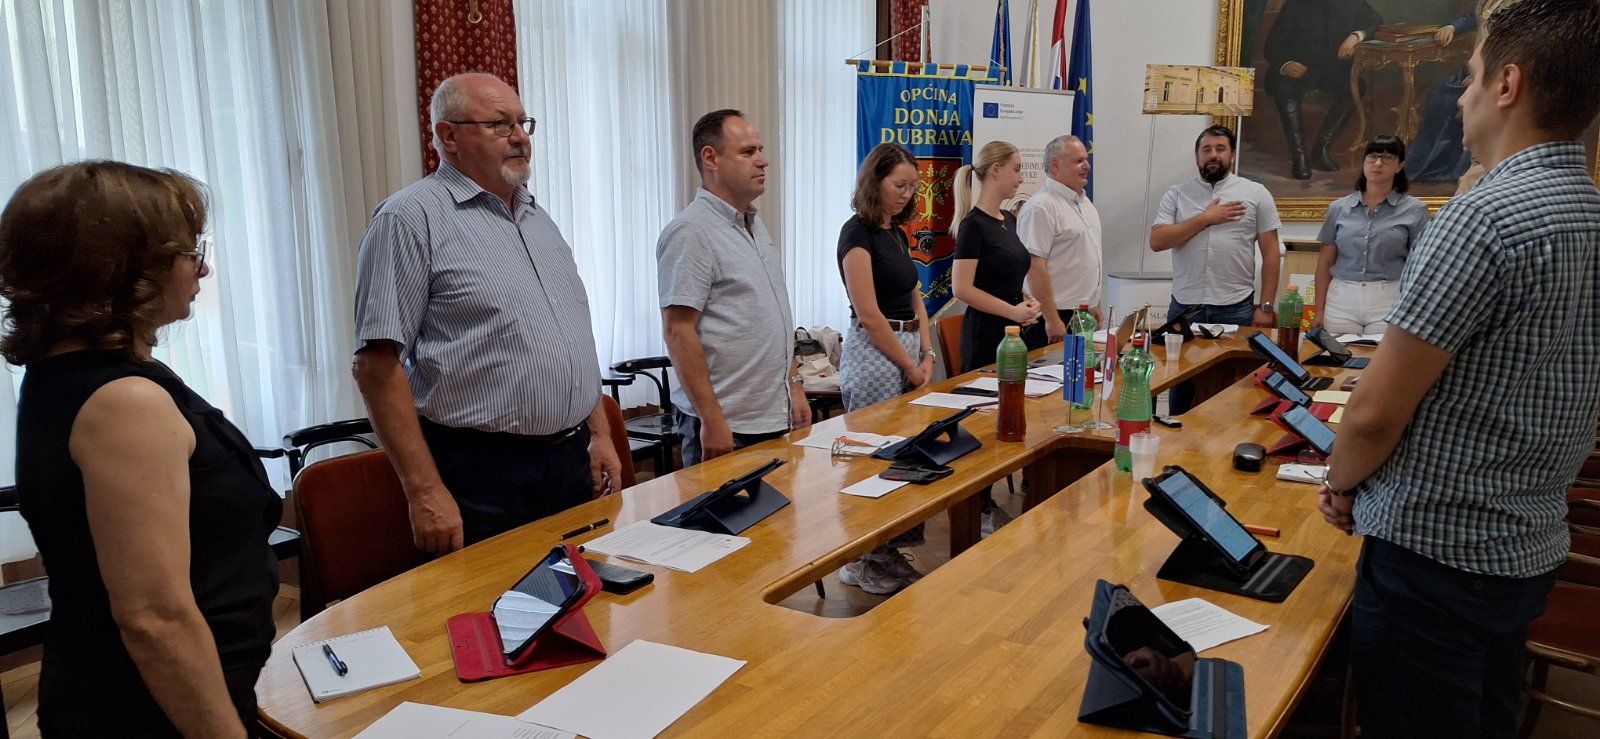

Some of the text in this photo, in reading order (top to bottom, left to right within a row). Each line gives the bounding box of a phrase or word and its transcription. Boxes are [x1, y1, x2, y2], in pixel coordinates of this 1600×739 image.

[900, 83, 957, 105] OPĆINA
[895, 108, 960, 126] DONJA
[881, 128, 973, 146] DUBRAVA
